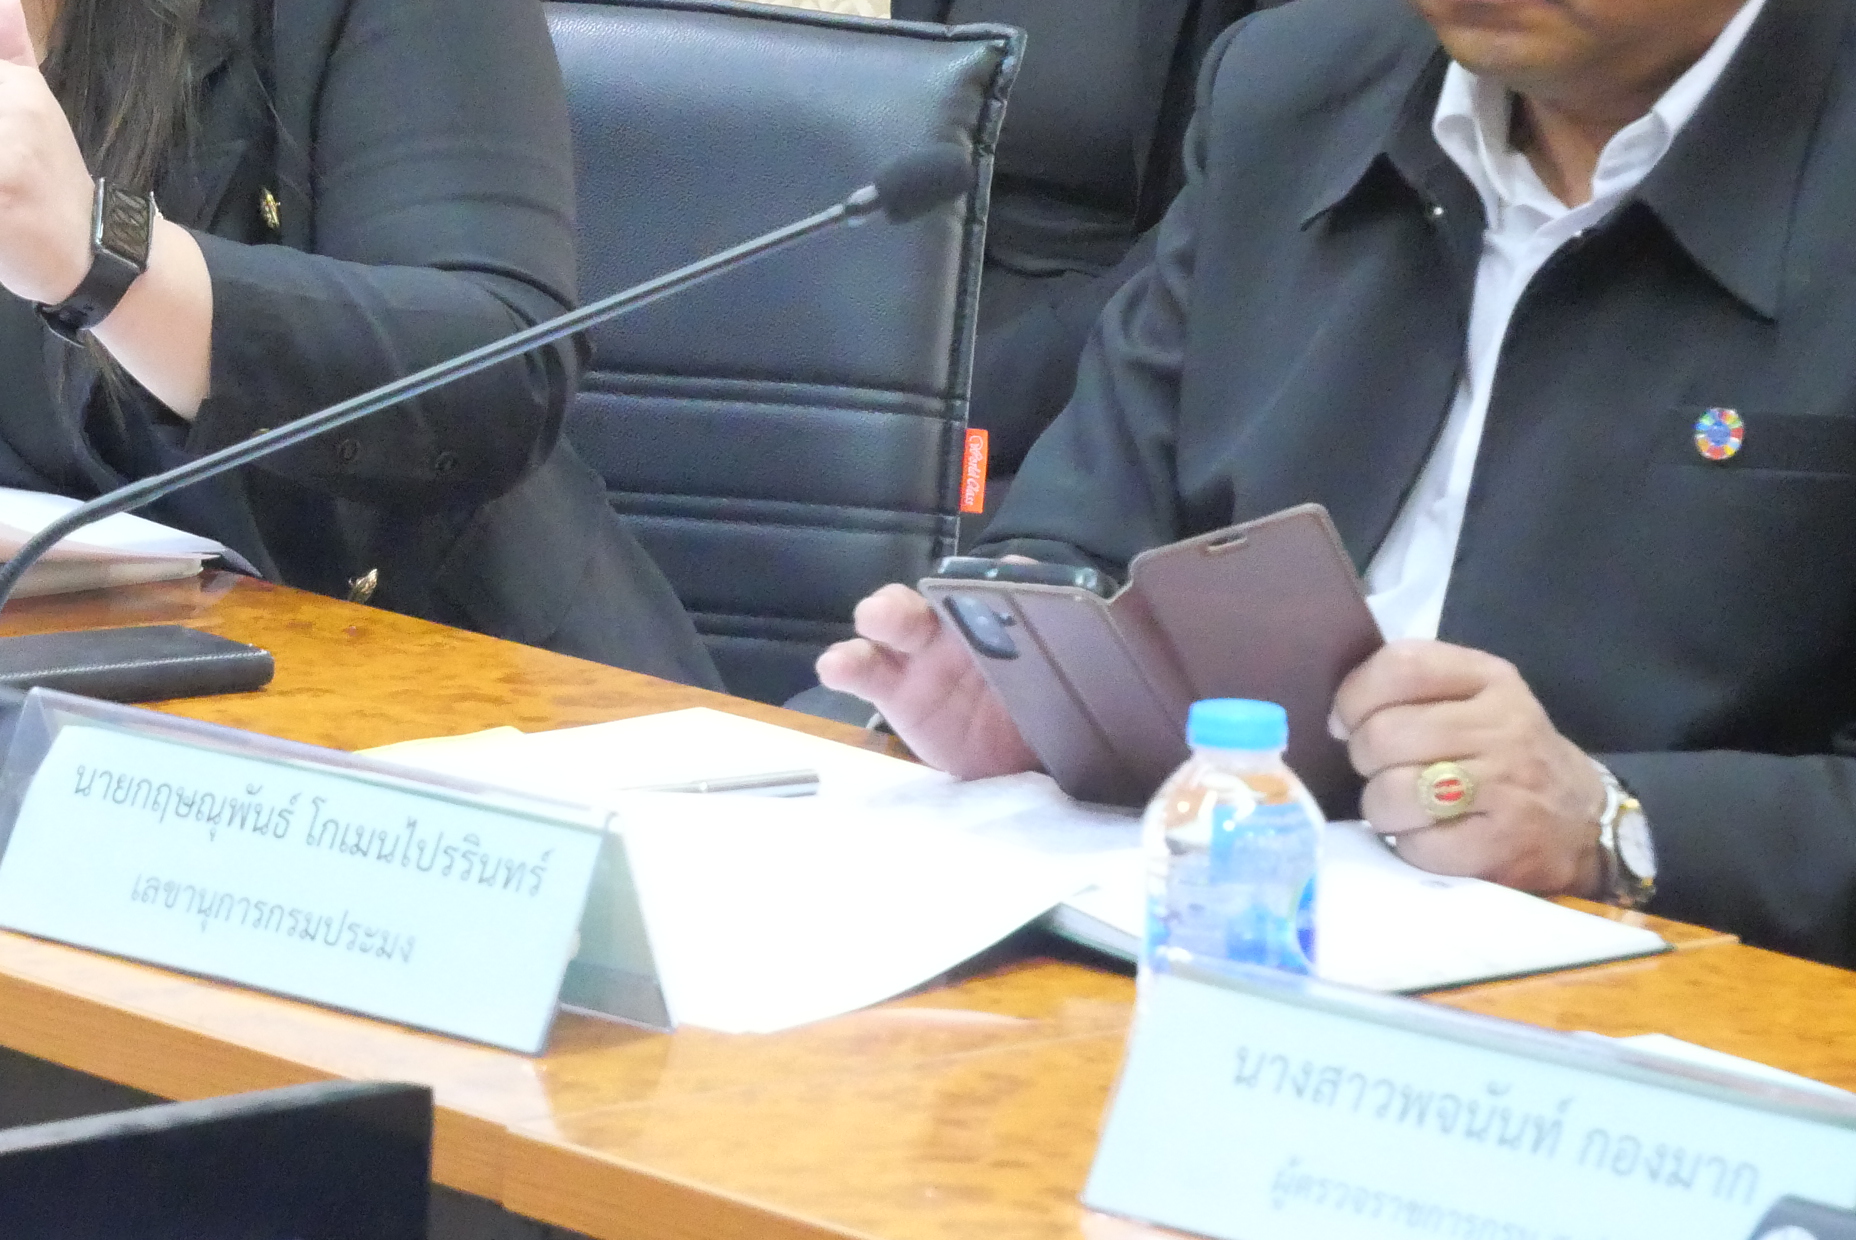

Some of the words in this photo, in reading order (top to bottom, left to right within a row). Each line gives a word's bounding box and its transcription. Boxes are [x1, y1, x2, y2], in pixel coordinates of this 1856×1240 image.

[72, 763, 303, 844] นายกฤษณุพันธ์
[130, 872, 417, 964] เลขานุการกรมประมง
[1231, 1043, 1576, 1160] นางสาวพจนันท์
[1575, 1124, 1762, 1207] กองมาก
